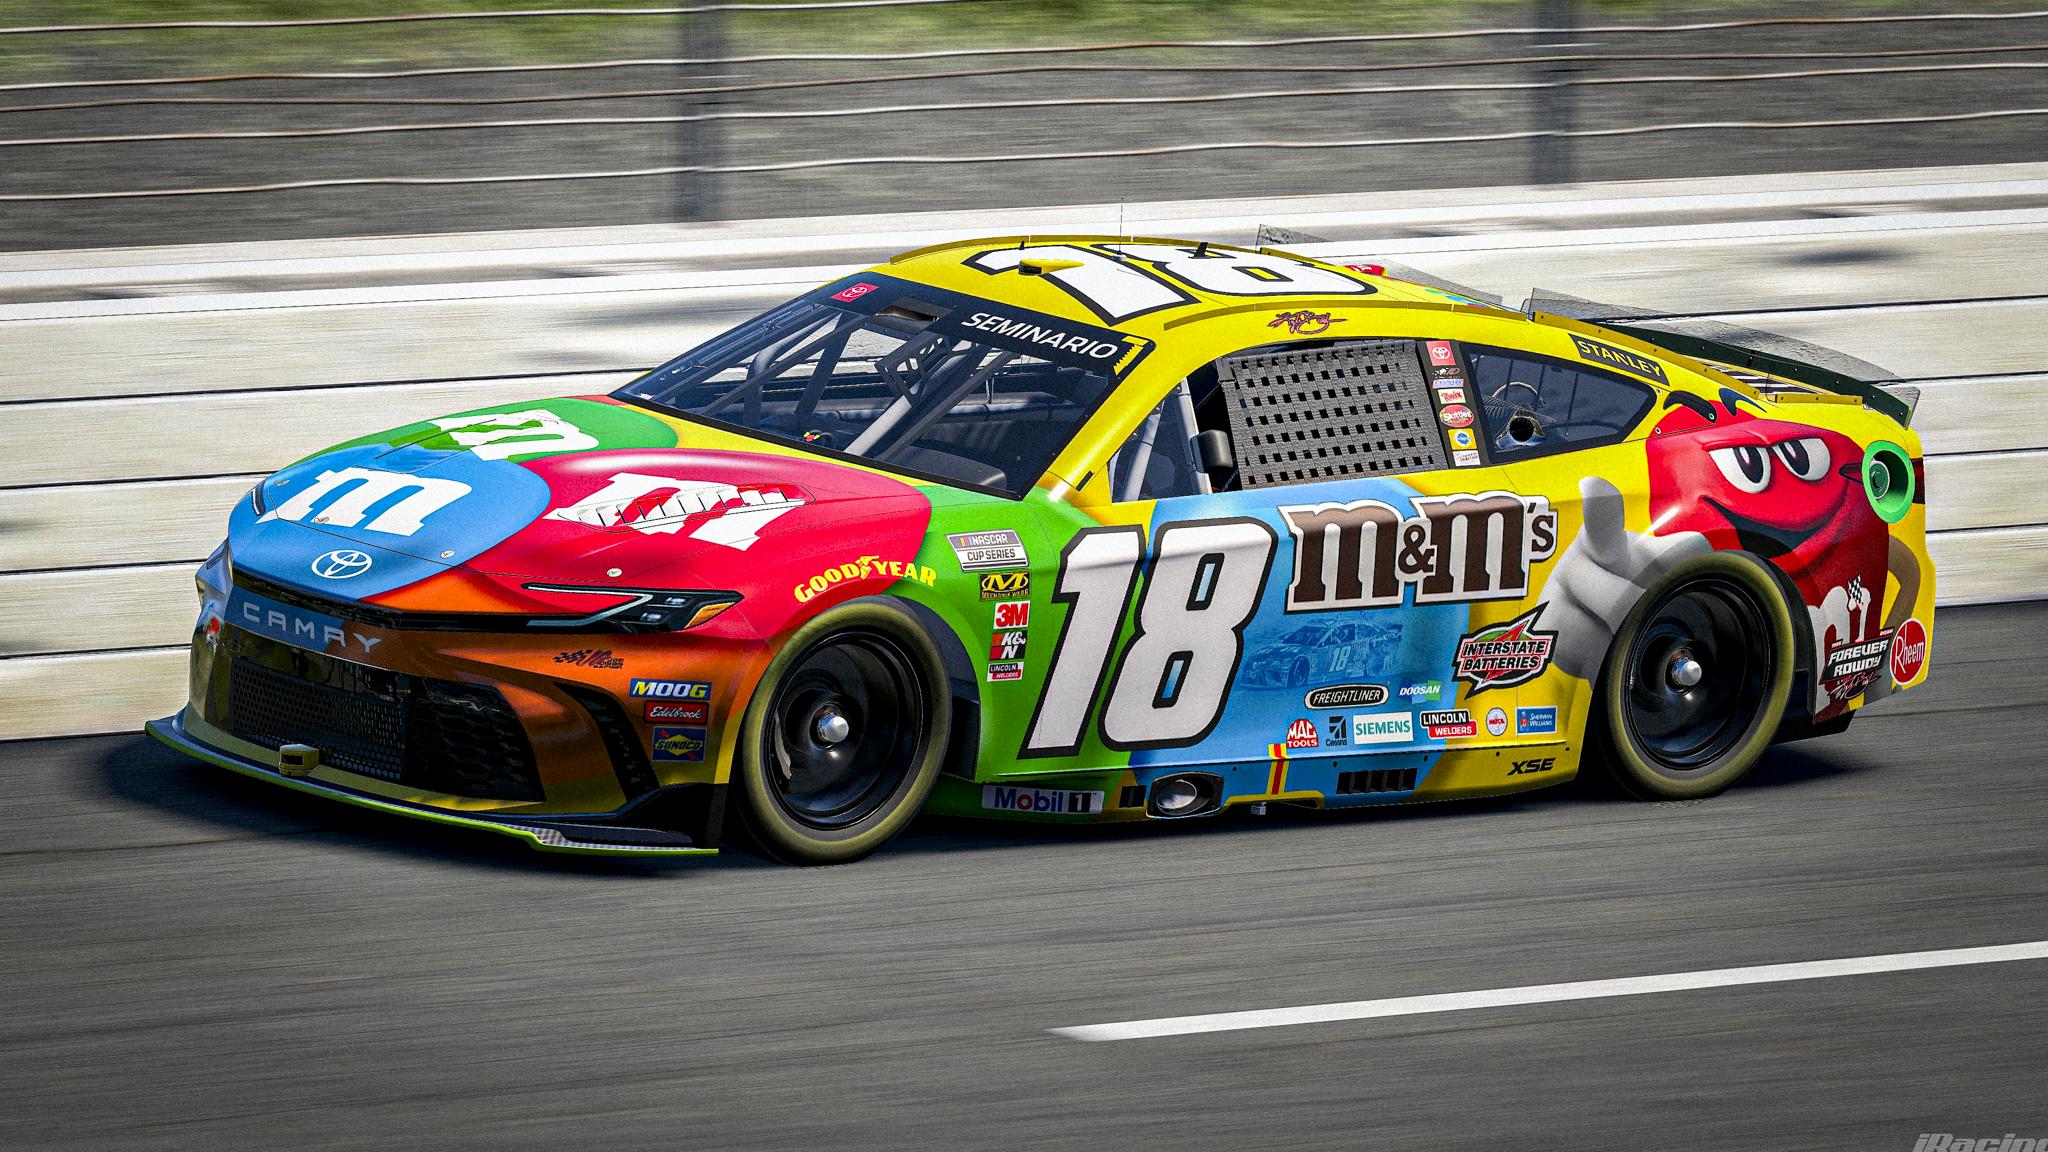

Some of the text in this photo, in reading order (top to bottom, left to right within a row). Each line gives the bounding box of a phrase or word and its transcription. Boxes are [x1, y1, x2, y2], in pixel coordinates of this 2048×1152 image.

[965, 242, 1376, 324] 18
[960, 312, 1118, 360] SEMINARIO
[1577, 340, 1662, 378] STANLEY
[1440, 391, 1463, 402] Twix
[1443, 411, 1472, 421] Skittles
[255, 466, 473, 537] m
[971, 534, 1008, 546] NASCAR
[967, 548, 1016, 561] CUP SERIES
[793, 558, 938, 603] GOODYEAR
[995, 603, 1029, 628] 3M
[243, 601, 382, 654] CAMRY
[1001, 631, 1026, 647] K&
[1020, 517, 1277, 757] 18
[1001, 646, 1018, 659] N
[1463, 641, 1546, 656] INTERSTATE
[1893, 623, 1925, 675] Rheem
[990, 664, 1017, 672] LINCOLN
[1463, 656, 1539, 671] BATTERIES
[1833, 656, 1882, 678] ROWDY
[632, 681, 709, 699] MOOG
[1312, 689, 1381, 704] FREIGHTLINER
[1399, 685, 1441, 697] DOOSAN
[650, 705, 702, 719] Edelbrock
[1422, 712, 1467, 725] LINCOLN
[1530, 713, 1553, 721] SHERWIN
[1287, 721, 1318, 740] MAC
[1355, 720, 1411, 736] SIEMENS
[1529, 719, 1553, 727] WILLIAMS
[1434, 726, 1473, 736] WELDERS
[656, 739, 702, 751] SUNOCO
[1287, 739, 1318, 748] TOOLS
[1325, 738, 1348, 747] Cessna
[1507, 757, 1557, 776] XSE
[994, 787, 1064, 812] Mobil
